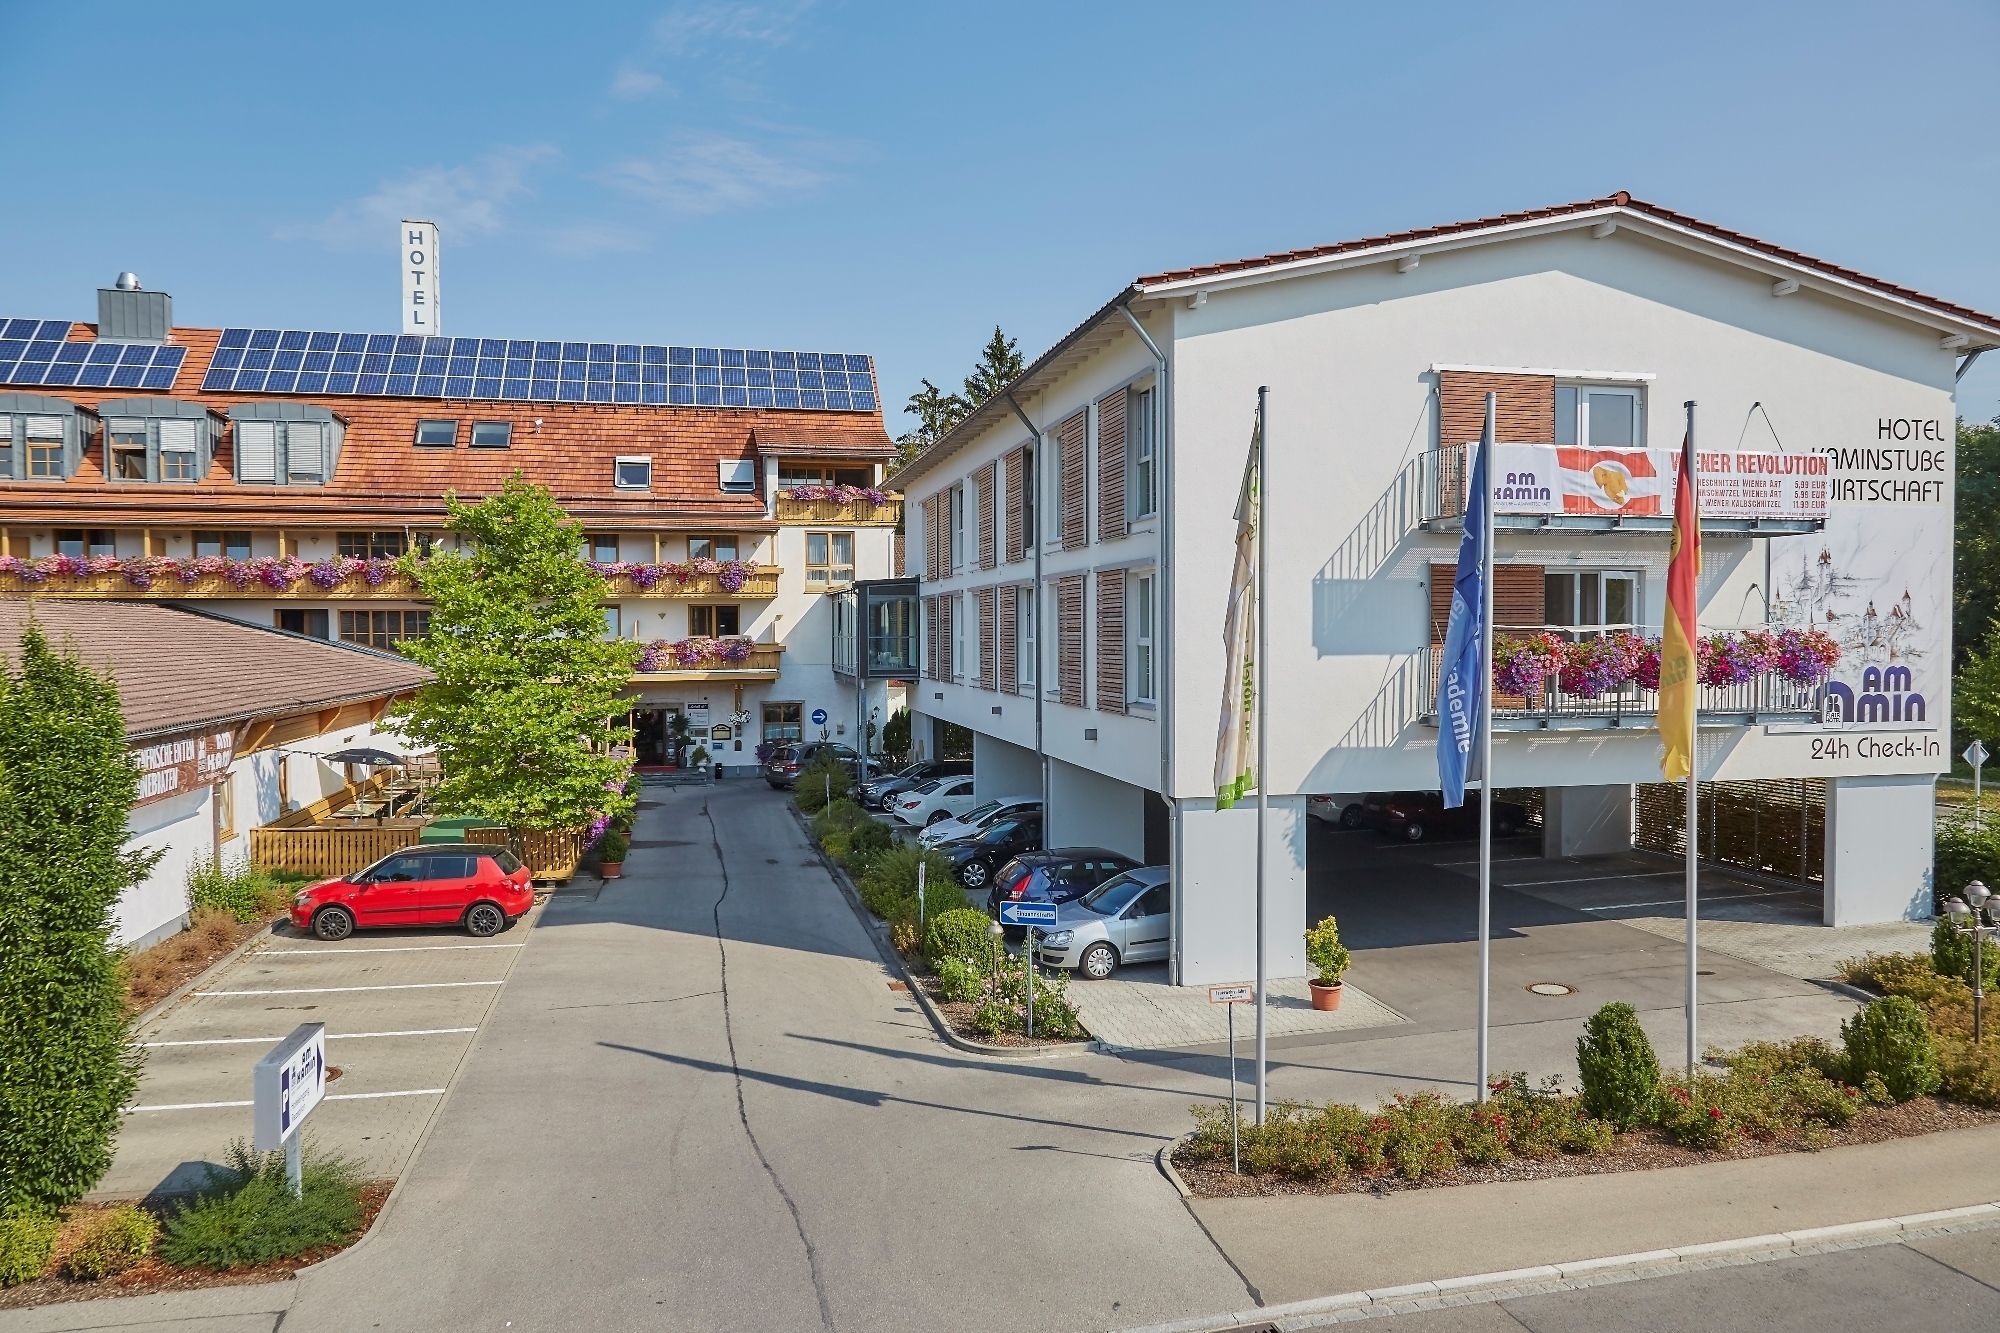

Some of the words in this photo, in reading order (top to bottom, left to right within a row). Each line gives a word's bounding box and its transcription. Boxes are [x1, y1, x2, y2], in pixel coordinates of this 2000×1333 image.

[408, 230, 426, 325] HOTEL
[1878, 418, 1945, 442] HOTEL
[1736, 453, 1828, 476] REVOLUTION
[1812, 447, 1945, 472] AMINSTUBE
[1506, 472, 1536, 486] AM
[1742, 479, 1767, 488] WIENER
[1769, 480, 1782, 488] ART
[1705, 499, 1730, 508] WIENER
[1731, 499, 1782, 509] KALBSCHNITZEL
[1742, 489, 1767, 498] WIENER
[1769, 490, 1782, 498] ART
[1862, 665, 1912, 693] AM
[1447, 667, 1471, 754] ademie
[1811, 737, 1849, 760] 24h
[1857, 735, 1940, 759] Check-In
[282, 1088, 289, 1114] P
